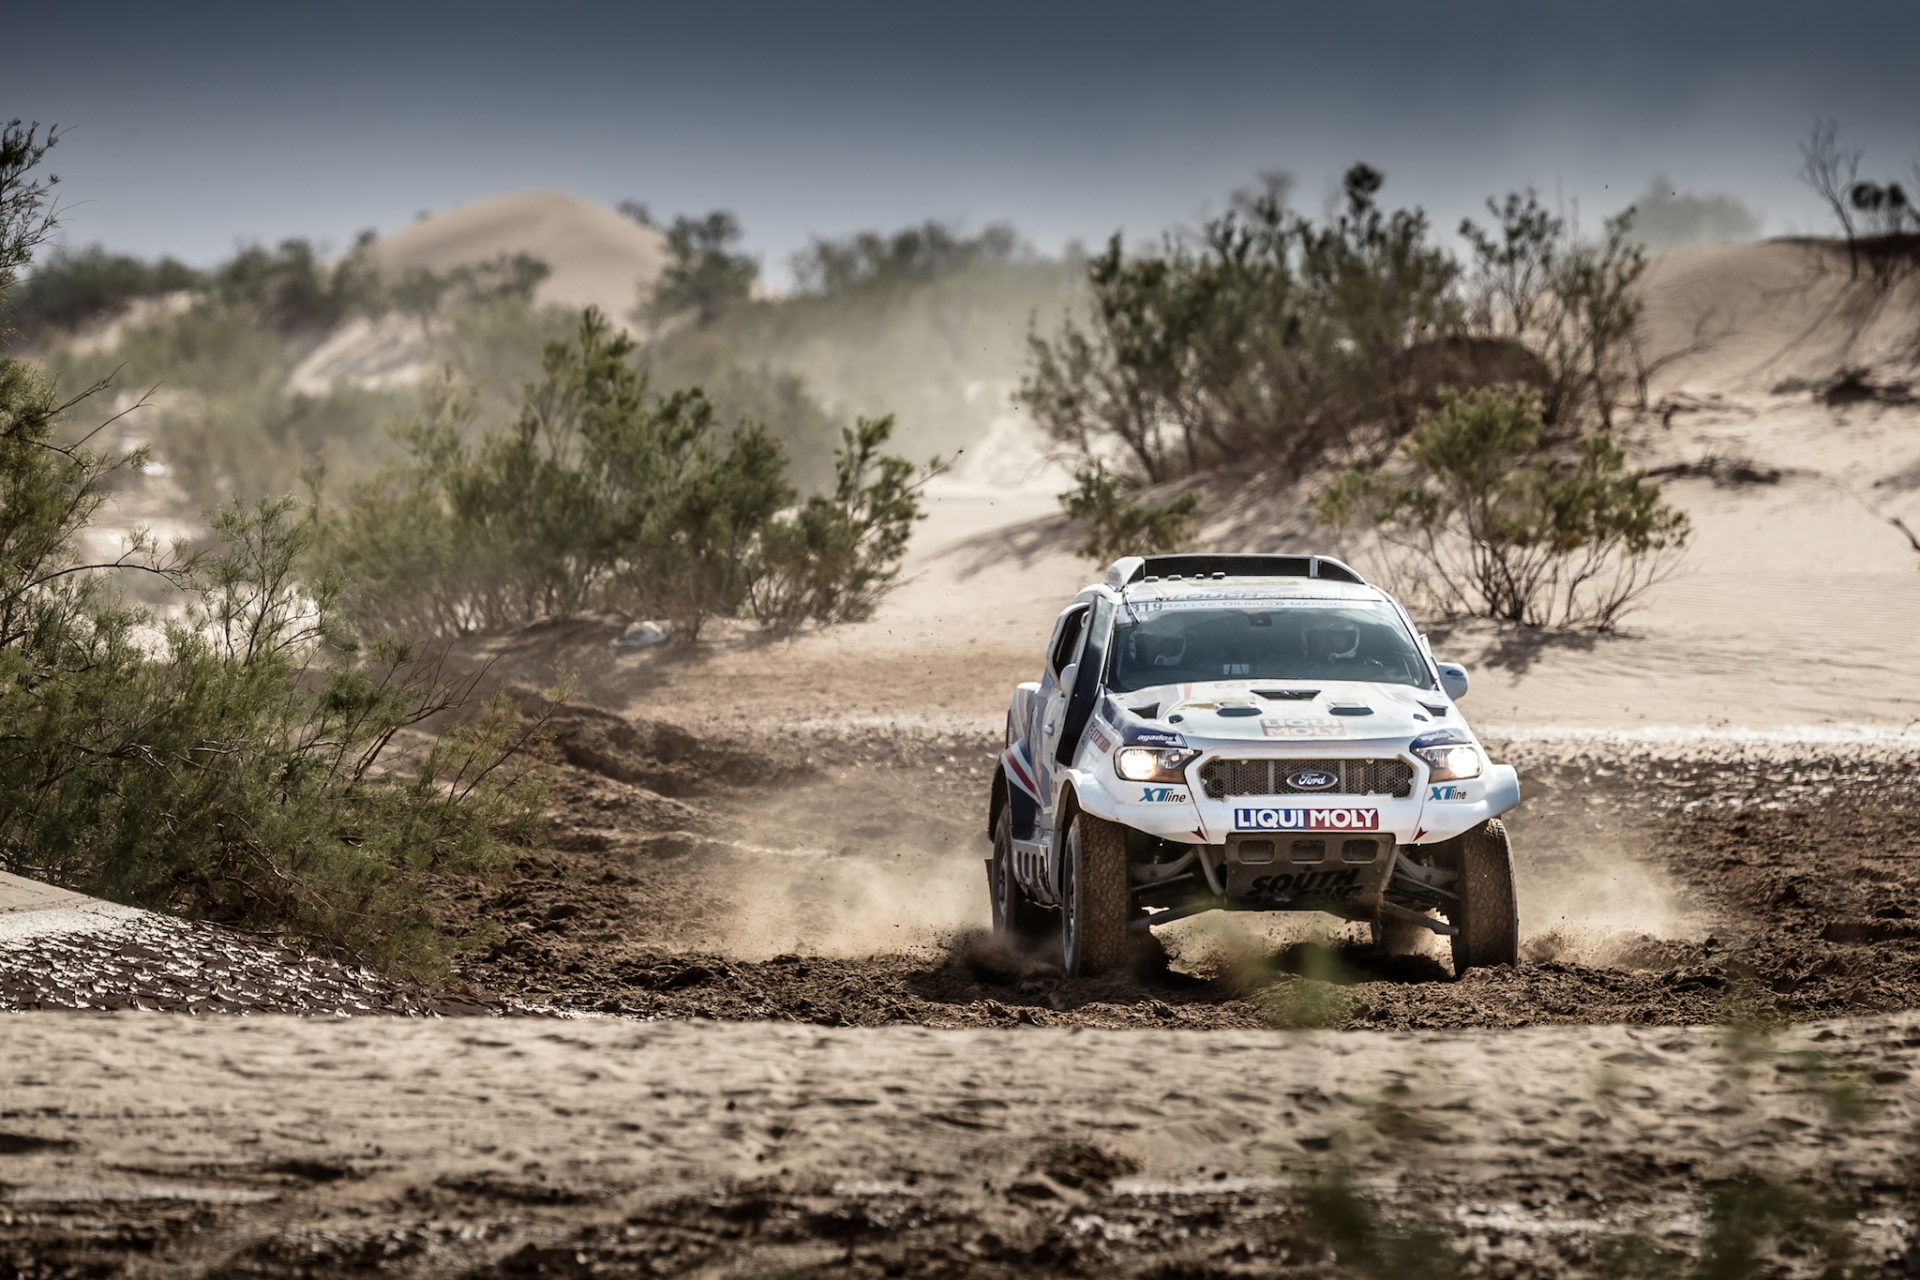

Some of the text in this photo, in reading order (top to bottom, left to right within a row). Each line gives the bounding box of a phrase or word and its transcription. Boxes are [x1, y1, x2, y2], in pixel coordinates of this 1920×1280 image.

[1264, 719, 1344, 728] LIQUI
[1266, 727, 1346, 737] MOLY
[1136, 733, 1174, 743] agados
[1298, 773, 1327, 785] Ford
[1236, 809, 1377, 828] LIQUI MOLY
[1247, 867, 1362, 896] SOUTH
